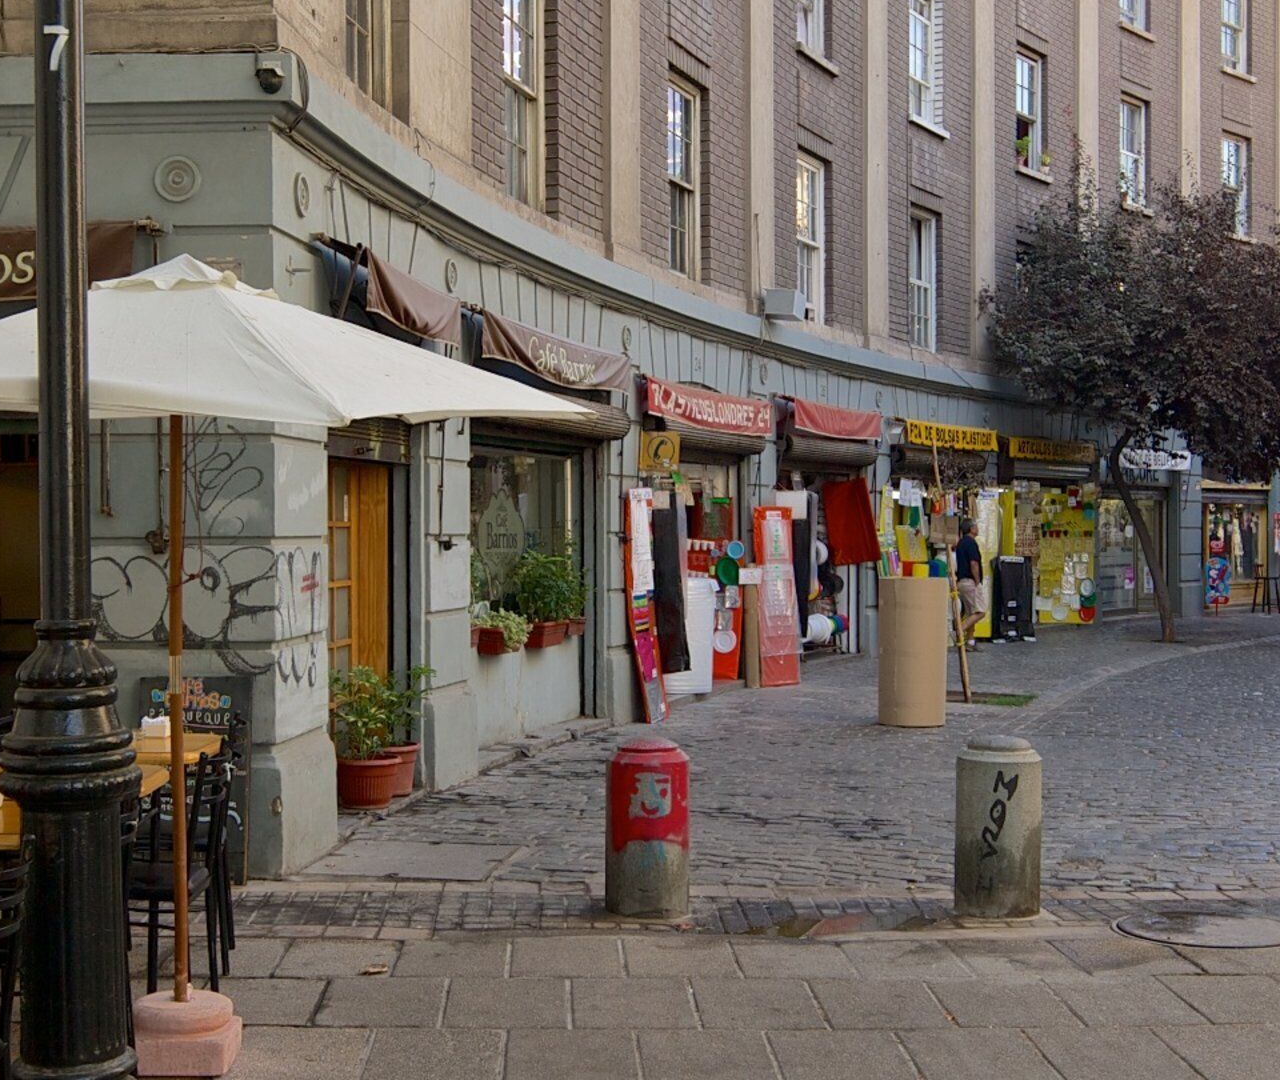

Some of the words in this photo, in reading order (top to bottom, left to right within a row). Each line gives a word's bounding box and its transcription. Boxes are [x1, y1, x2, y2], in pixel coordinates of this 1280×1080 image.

[44, 25, 69, 71] 7
[528, 336, 557, 373] Café
[712, 399, 755, 428] LONDRES
[757, 407, 771, 428] 24
[924, 424, 933, 441] DE
[936, 427, 960, 445] BOLSAS
[486, 522, 518, 550] Barrios
